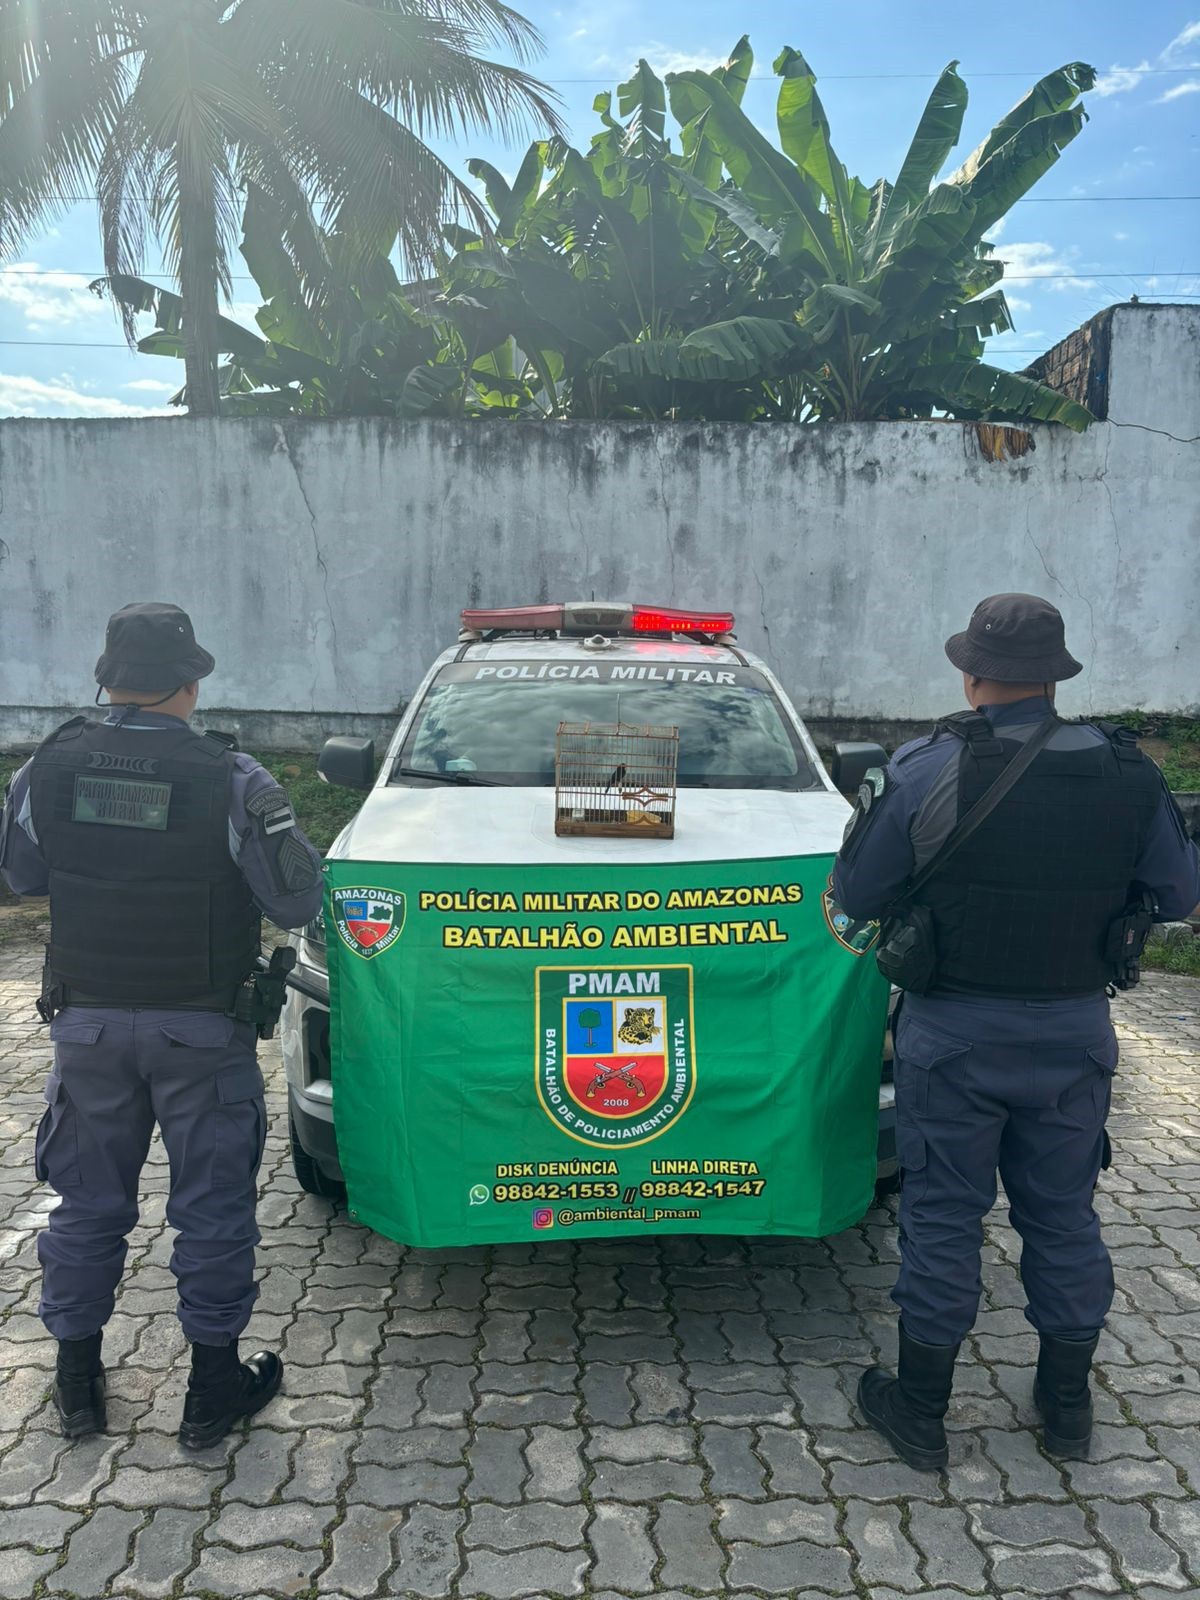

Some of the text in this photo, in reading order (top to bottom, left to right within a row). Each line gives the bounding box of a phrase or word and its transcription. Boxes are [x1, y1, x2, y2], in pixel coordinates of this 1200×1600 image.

[475, 663, 736, 685] POLÍCIA MILITAR
[79, 779, 168, 806] PATRULHAMENTO
[96, 799, 144, 821] RURAL
[334, 889, 402, 906] AMAZONAS
[419, 885, 802, 911] POLÍCIA MILITAR DO AMAZONAS
[337, 920, 400, 950] Polícia Militar
[443, 920, 787, 948] BATALHÃO AMBIENTAL
[568, 972, 661, 994] PMAM
[545, 1018, 687, 1139] BATALHÃO DE POLICIAMENTO AMBIENTAL
[603, 1098, 630, 1107] 2008
[497, 1160, 618, 1177] DISK DENÚNCIA
[652, 1160, 759, 1175] LINHA DIRETA
[494, 1183, 619, 1200] 98842-1553
[641, 1180, 766, 1197] 98842-1547
[558, 1208, 701, 1224] @ambiental_pmam
